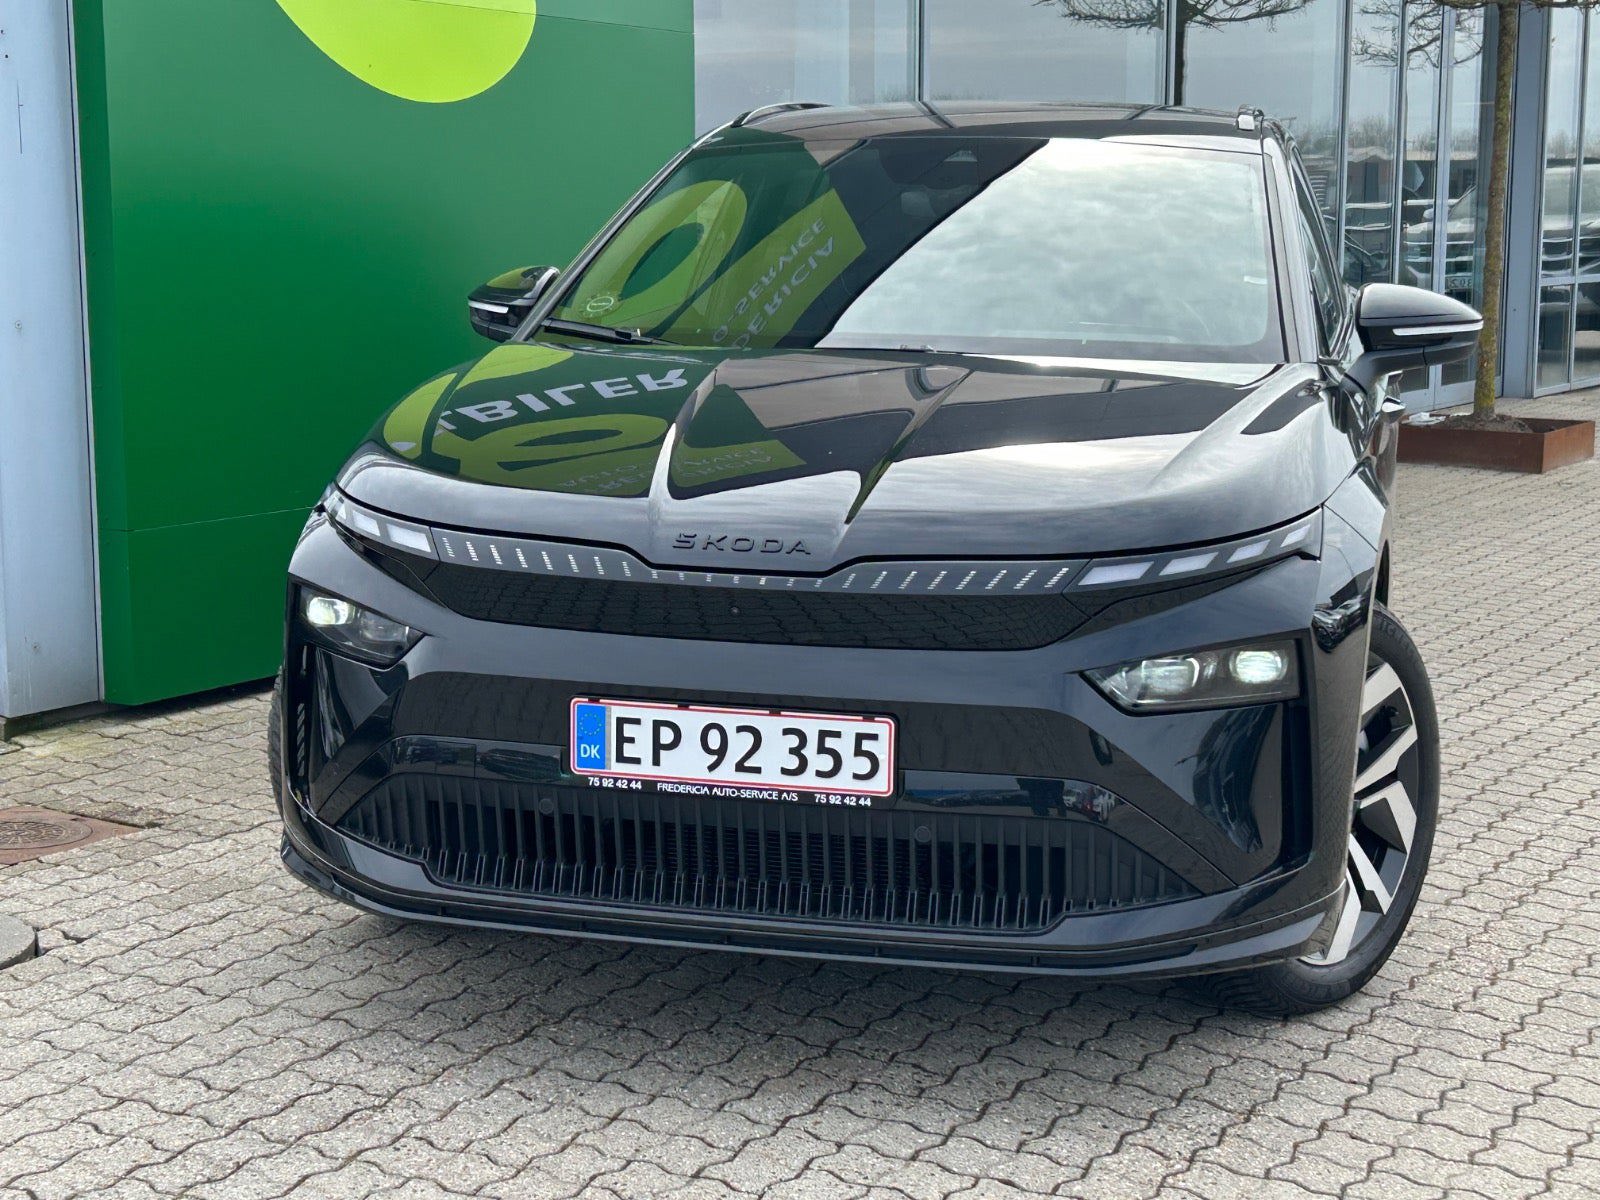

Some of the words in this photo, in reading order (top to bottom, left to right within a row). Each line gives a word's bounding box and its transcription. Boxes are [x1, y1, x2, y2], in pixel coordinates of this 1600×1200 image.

[580, 743, 600, 759] DK
[615, 716, 682, 767] EP
[699, 722, 763, 774] 92
[780, 727, 880, 781] 355
[588, 777, 600, 787] 75
[601, 779, 614, 788] 92
[615, 780, 628, 789] 42
[629, 781, 642, 790] 44
[657, 782, 710, 795] FREDERICIA
[711, 787, 779, 799] AUTO-SERVICE
[781, 792, 799, 802] A/S
[814, 793, 827, 804] 75
[828, 795, 842, 805] 92
[843, 796, 857, 806] 42
[858, 797, 872, 807] 44
